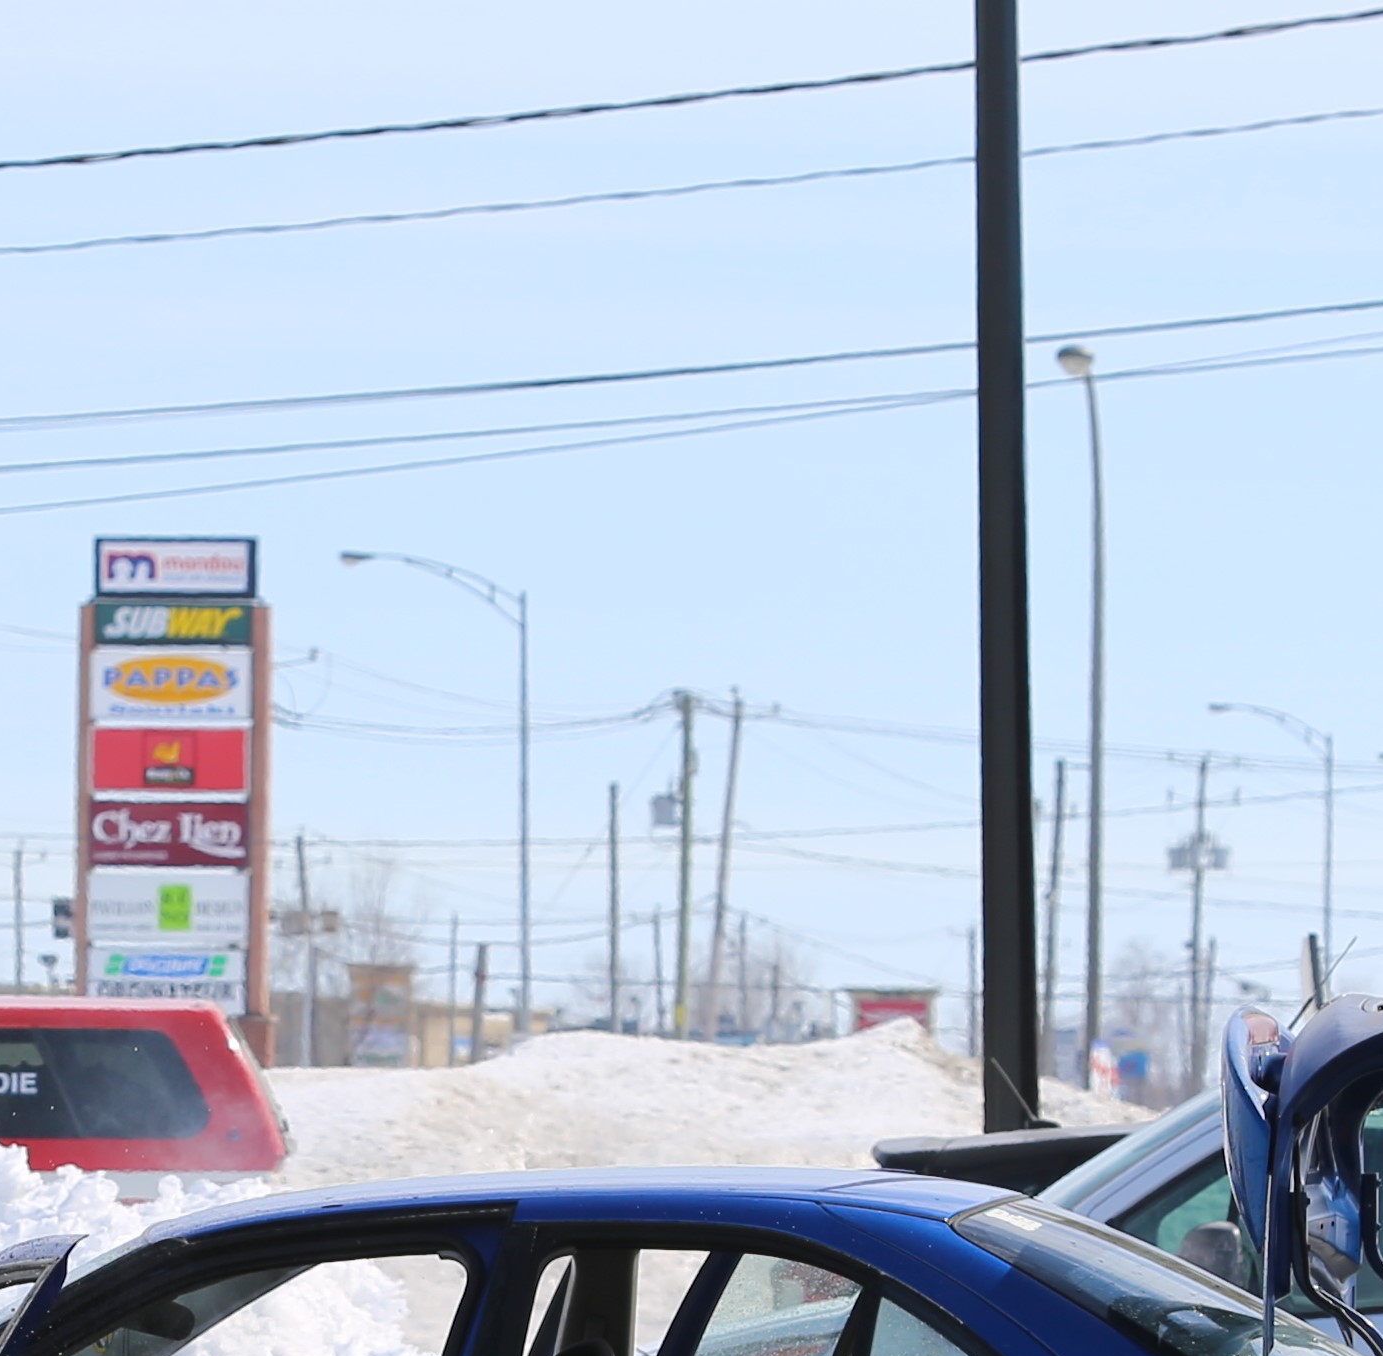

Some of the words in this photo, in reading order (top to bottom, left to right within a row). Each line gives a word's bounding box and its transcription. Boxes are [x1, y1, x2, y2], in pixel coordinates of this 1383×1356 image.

[102, 605, 244, 639] SUBWAY
[102, 666, 239, 688] PAPPAS
[92, 808, 172, 849] Chez
